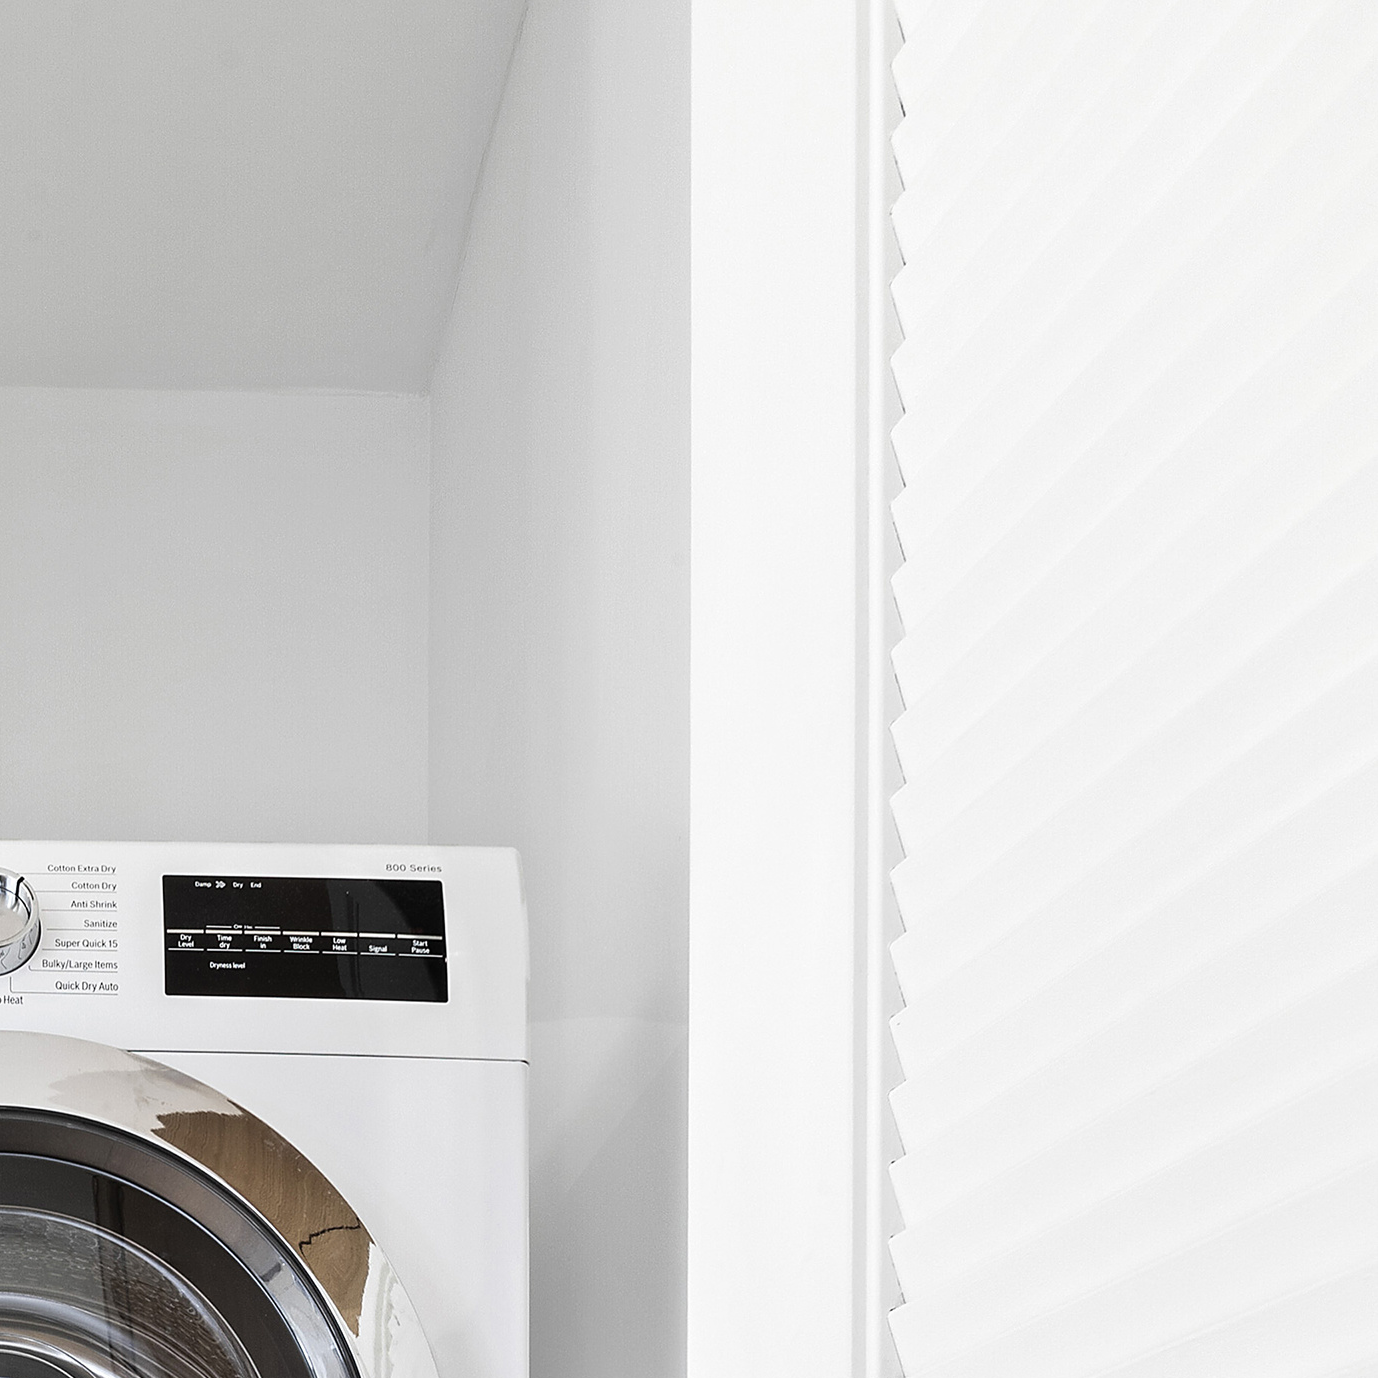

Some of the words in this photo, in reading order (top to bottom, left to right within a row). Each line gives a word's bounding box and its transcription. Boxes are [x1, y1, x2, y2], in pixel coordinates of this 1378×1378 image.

[48, 864, 75, 872] Cotton
[101, 865, 116, 873] Dry
[410, 864, 442, 872] Series
[102, 882, 117, 891] Dry
[55, 939, 80, 947] Super
[82, 939, 106, 947] Quick
[219, 942, 230, 950] dry
[369, 945, 387, 953] Signal
[42, 959, 93, 970] Bulky/Large
[95, 961, 118, 969] Items
[55, 981, 79, 990] Quick
[82, 981, 97, 992] Dry
[99, 982, 118, 991] Auto
[4, 995, 23, 1004] Heat
